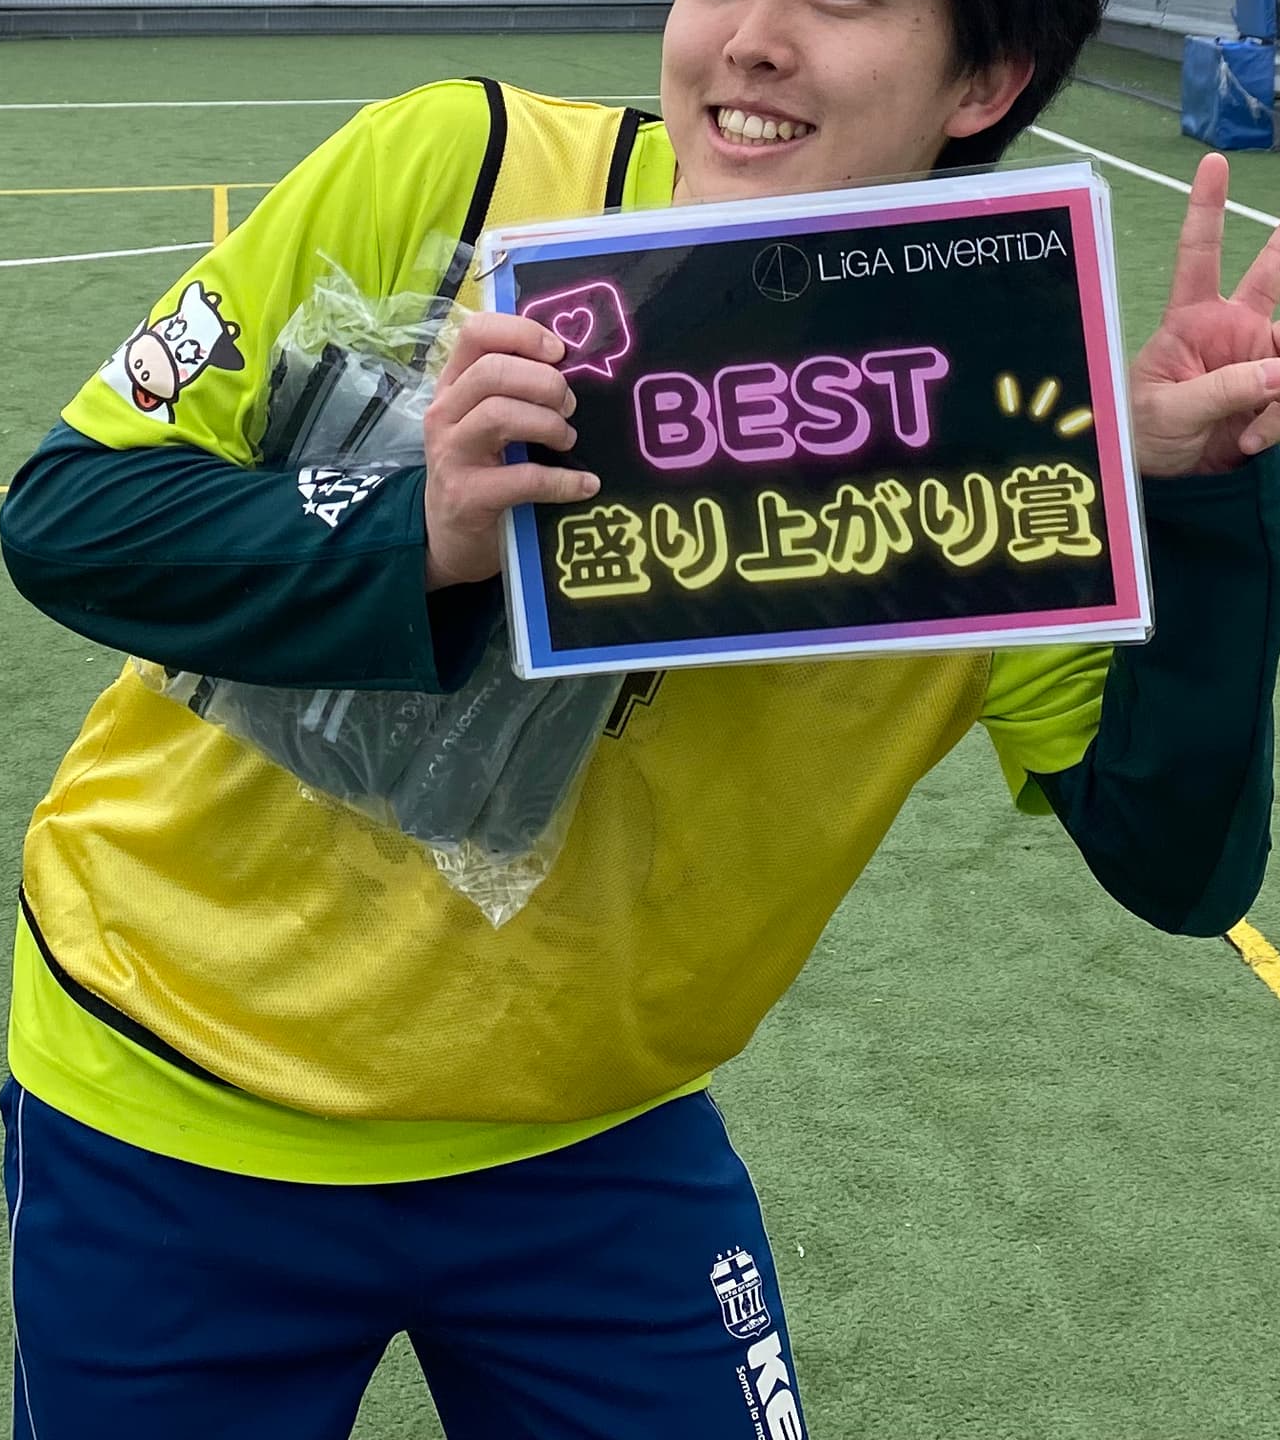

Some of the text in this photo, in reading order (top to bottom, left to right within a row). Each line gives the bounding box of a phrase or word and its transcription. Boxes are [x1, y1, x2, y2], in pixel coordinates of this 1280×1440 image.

[633, 346, 949, 470] BEST
[556, 462, 1104, 600] 盛り上がり賞
[736, 1365, 755, 1407] Somos
[750, 1406, 759, 1421] la
